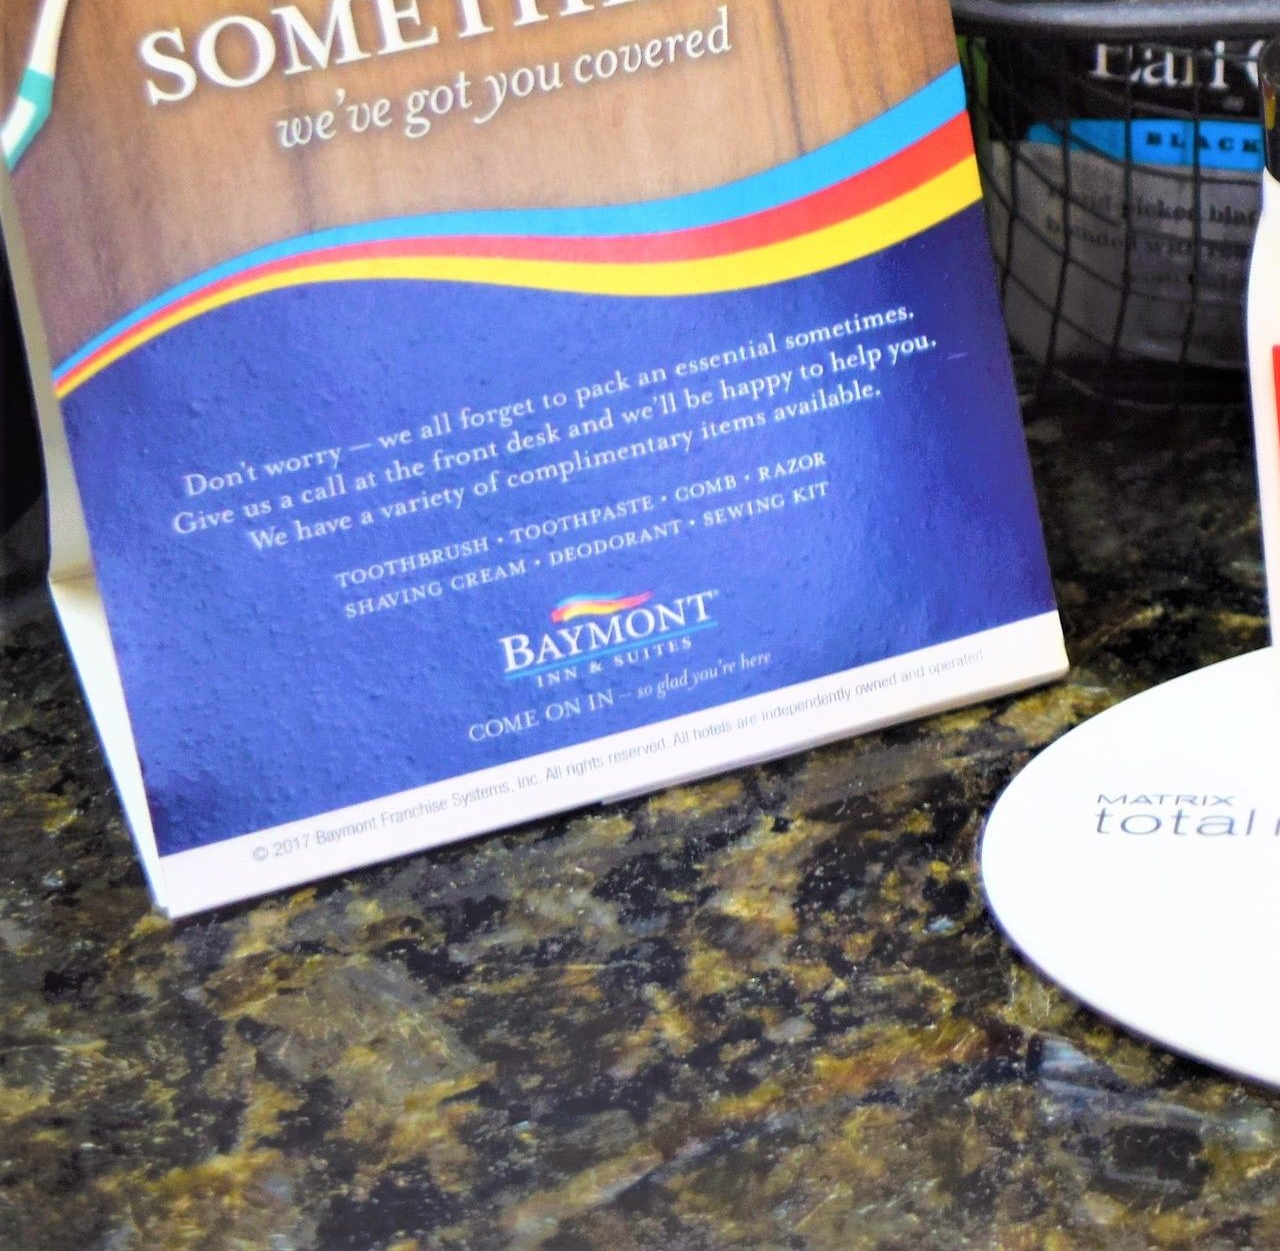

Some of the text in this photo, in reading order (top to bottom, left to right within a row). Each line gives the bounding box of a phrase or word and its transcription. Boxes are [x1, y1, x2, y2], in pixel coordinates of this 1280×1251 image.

[274, 4, 732, 149] we've got you covered
[171, 333, 937, 535] Give us a call at the front desk and we'll be happy to help you.
[180, 304, 915, 497] Don't worry we all forget to pack an essential sometimes.
[246, 378, 881, 551] We have a variety of complimentary items available.
[333, 450, 827, 589] TOOTHBRUSH TOOTHPASTE COMB RAZOR
[343, 480, 829, 619] SHAVING CREAM DEODORANT SEWING KIT
[466, 651, 772, 742] COME ON IN so glad you're here
[536, 636, 692, 688] INN & SUITES
[1095, 808, 1256, 837] total
[1097, 794, 1235, 807] MATRIX
